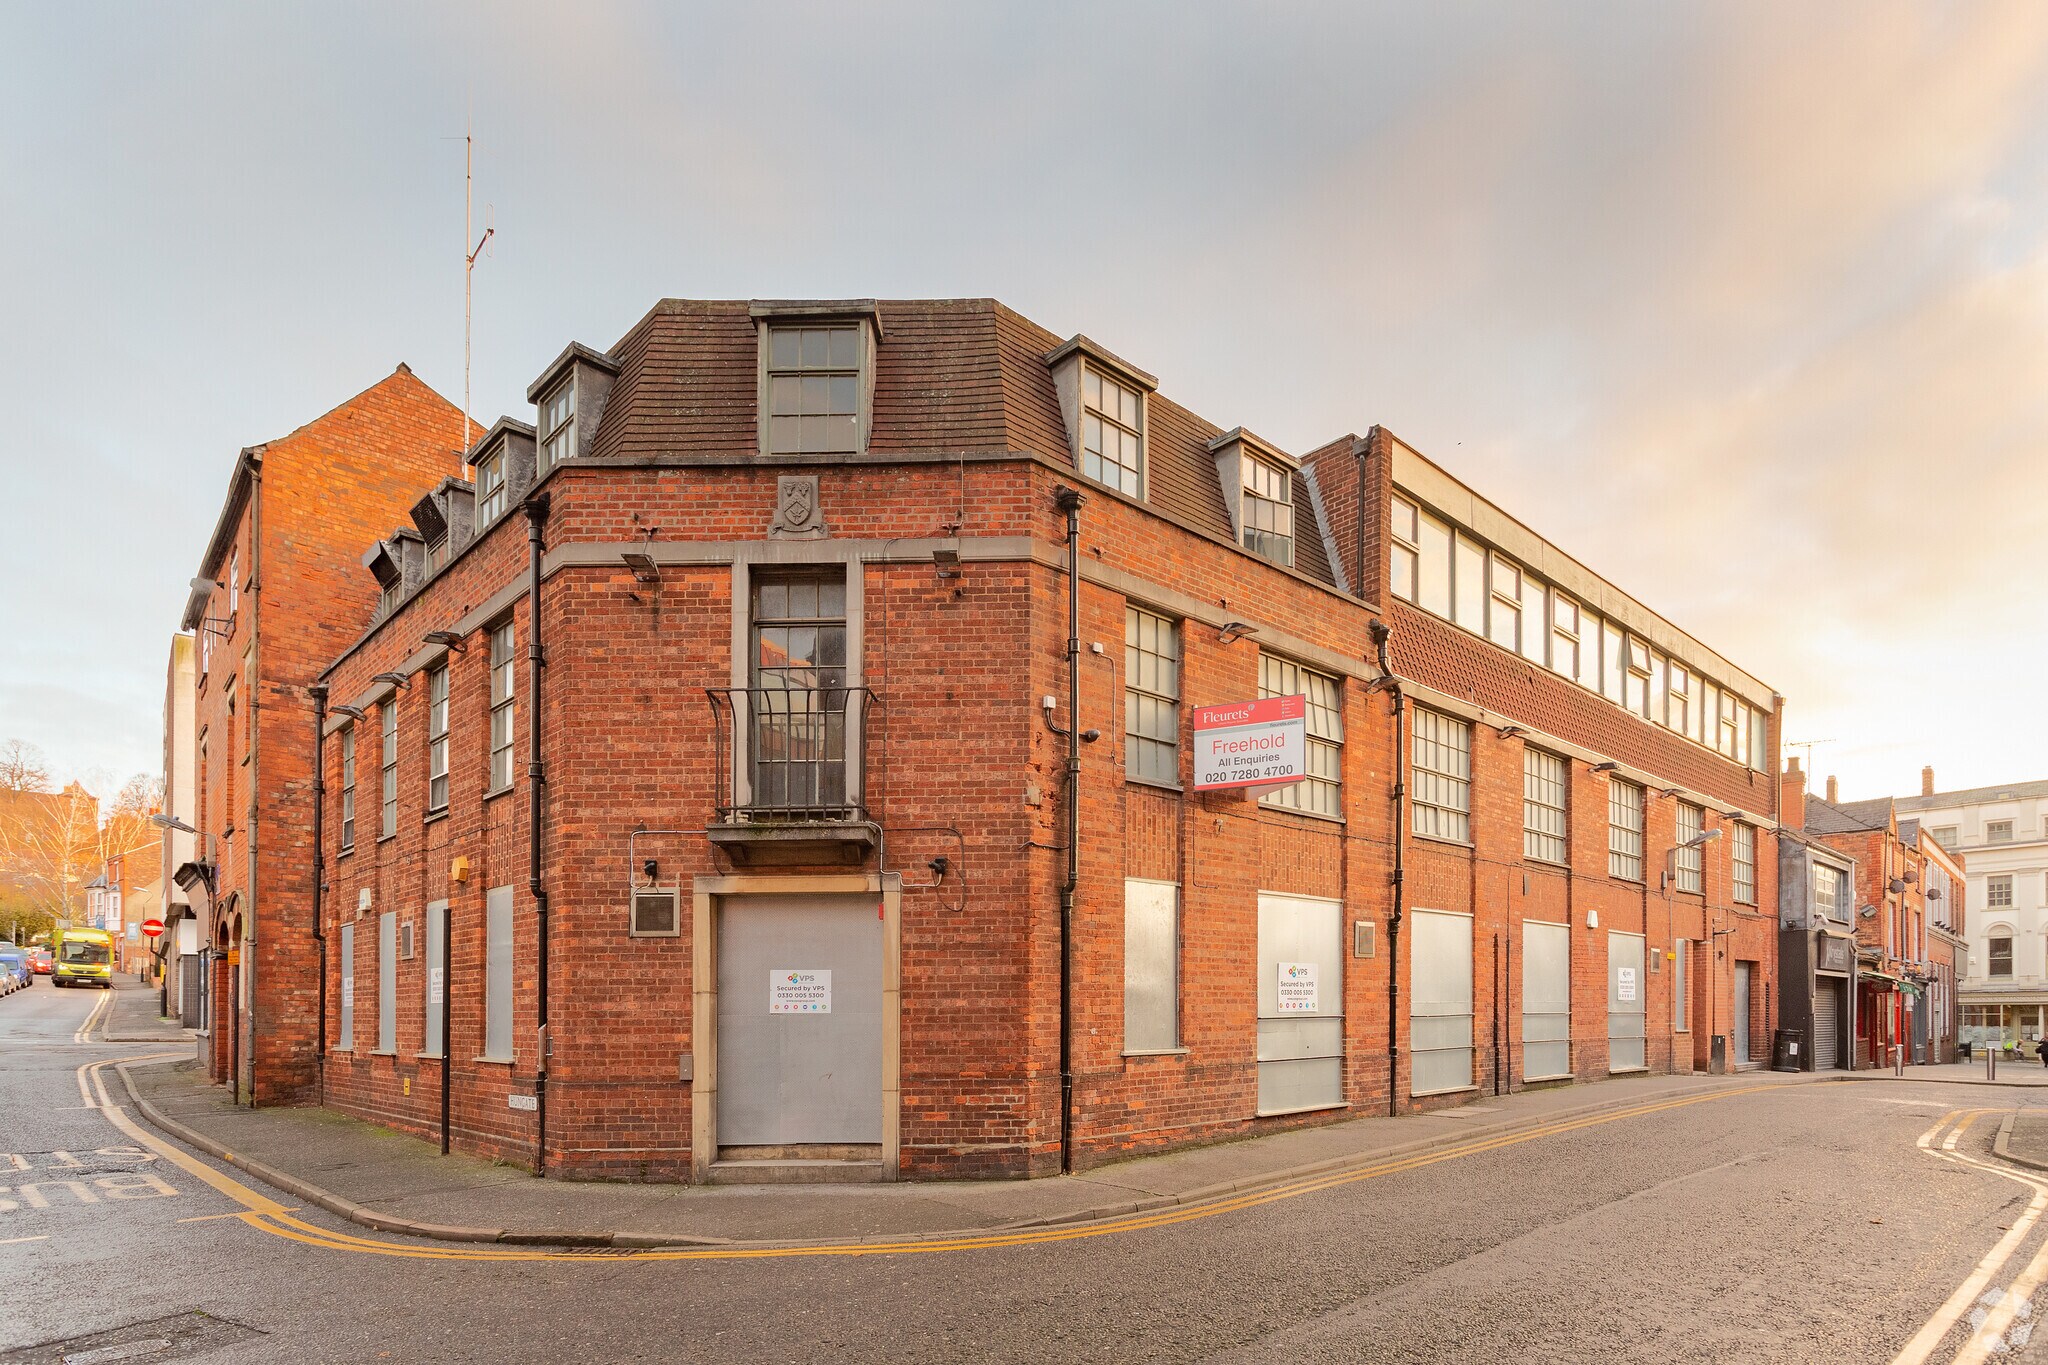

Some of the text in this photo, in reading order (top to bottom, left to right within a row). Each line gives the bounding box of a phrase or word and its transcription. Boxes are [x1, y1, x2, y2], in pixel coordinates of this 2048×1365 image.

[1203, 709, 1249, 724] Fleurets
[1212, 732, 1285, 755] Freehold
[1218, 753, 1280, 767] All Enquiries
[1205, 764, 1293, 783] 020 7280 4700
[1296, 968, 1308, 976] VPS
[510, 1095, 535, 1109] HUNGATE
